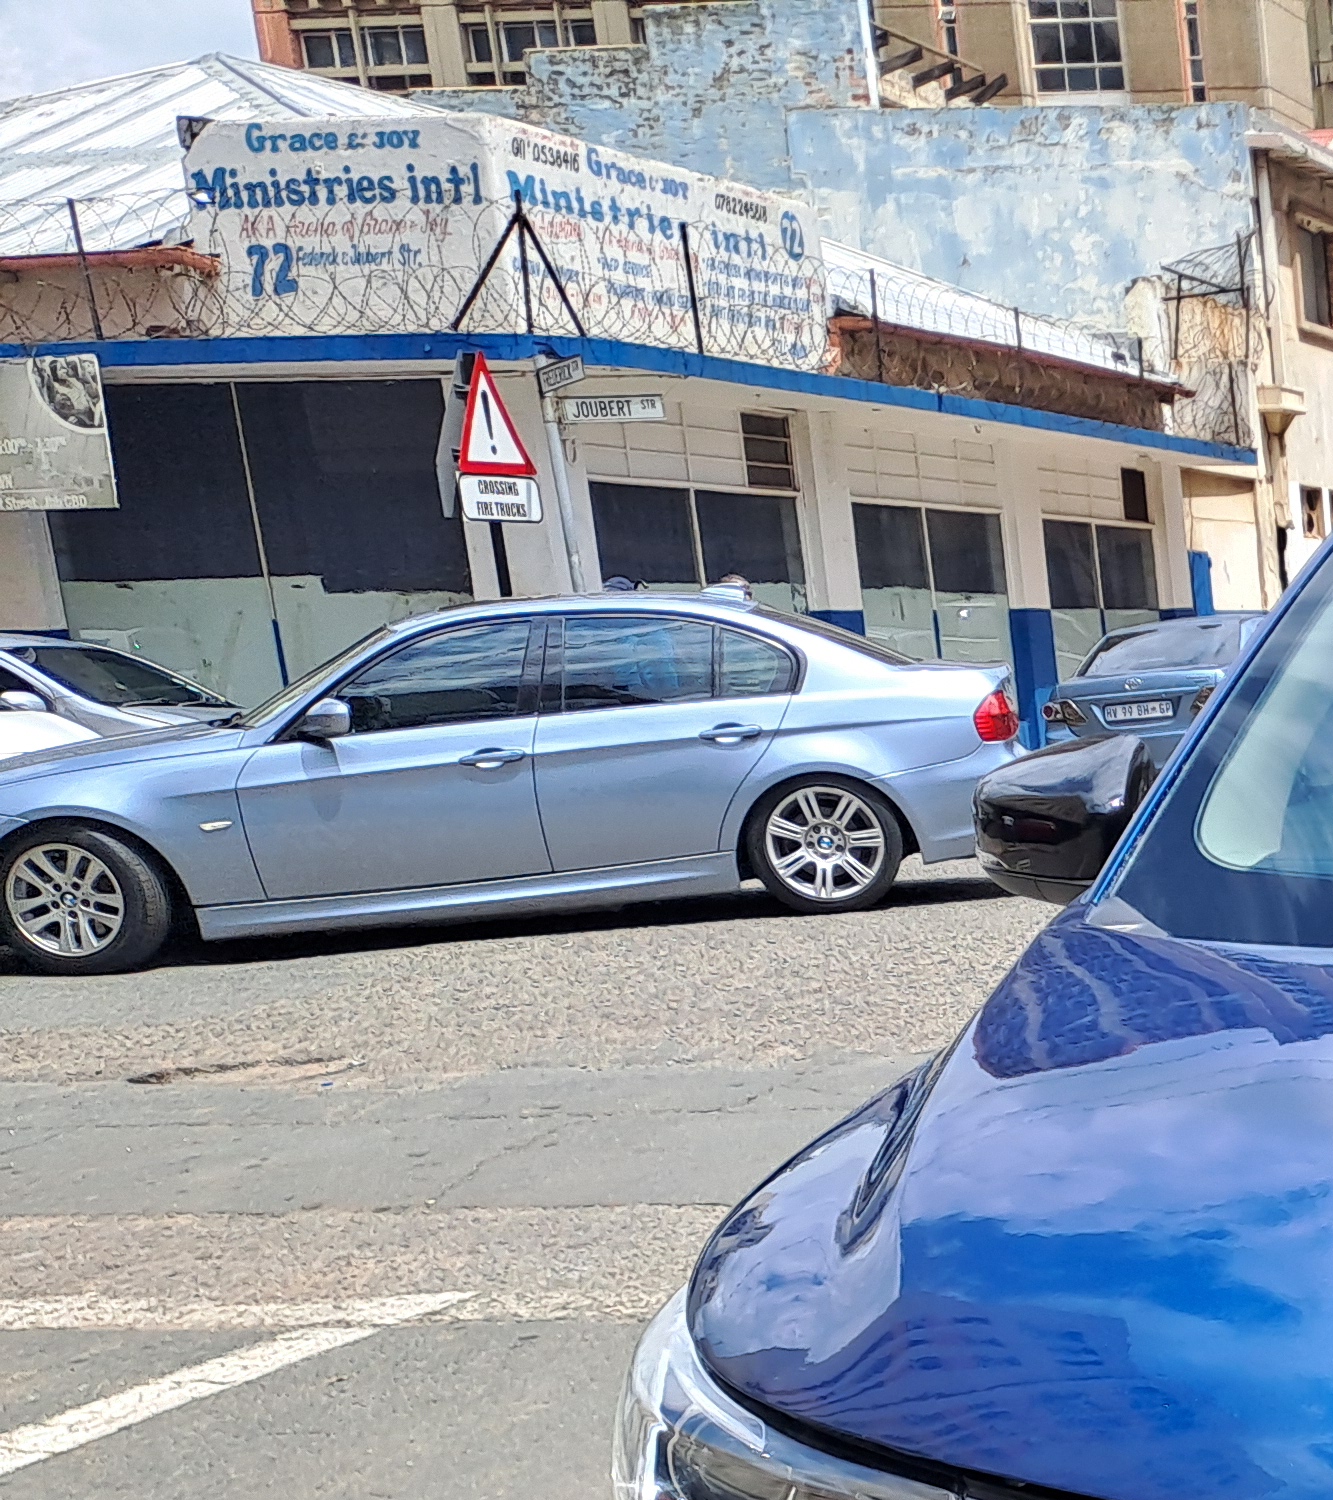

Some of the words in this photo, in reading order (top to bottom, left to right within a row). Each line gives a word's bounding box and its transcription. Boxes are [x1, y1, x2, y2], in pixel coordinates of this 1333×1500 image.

[245, 122, 339, 153] Grace
[372, 129, 421, 149] JOY
[587, 147, 647, 191] Grace
[191, 164, 397, 210] Ministries
[506, 169, 688, 242] Ministrie
[239, 213, 277, 240] AKA
[247, 243, 298, 297] 72
[572, 399, 632, 419] JOUBERT
[641, 398, 656, 410] STR
[478, 480, 519, 496] CROSSING
[477, 502, 494, 517] FIRE
[495, 502, 527, 517] TRUCKS
[1159, 702, 1171, 714] GP
